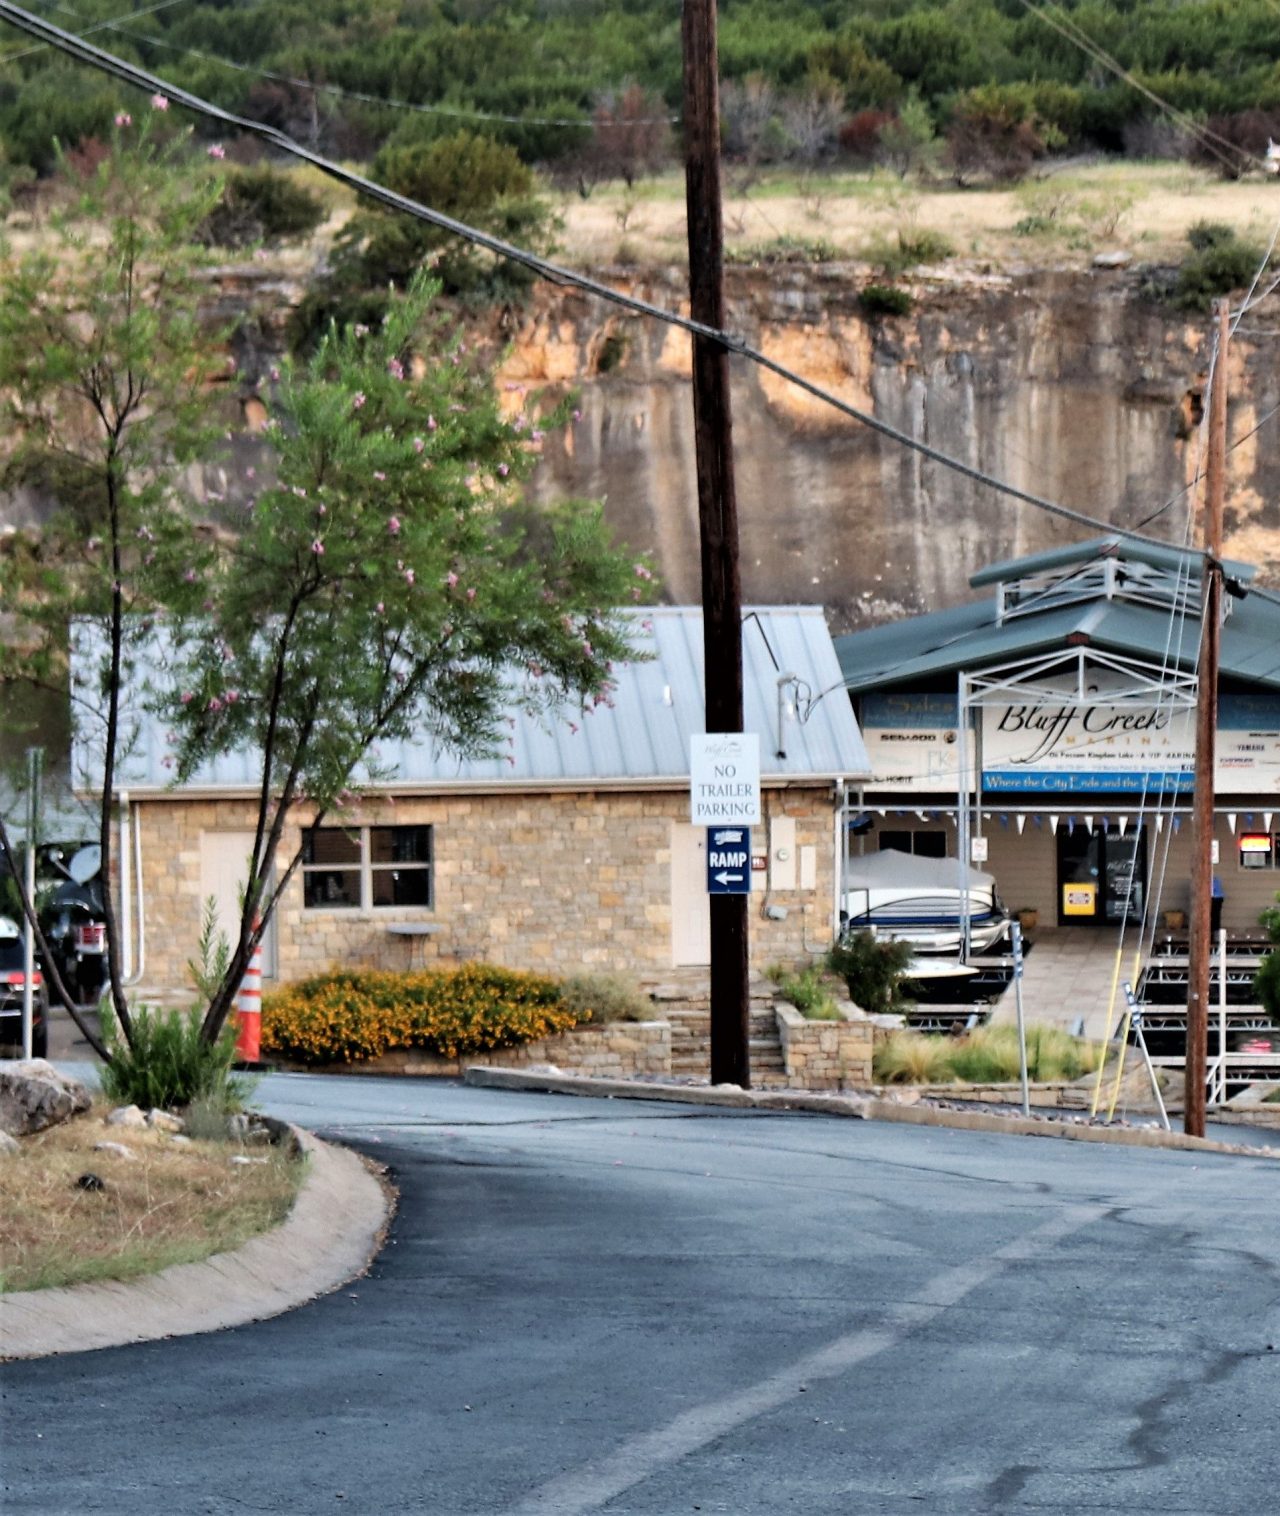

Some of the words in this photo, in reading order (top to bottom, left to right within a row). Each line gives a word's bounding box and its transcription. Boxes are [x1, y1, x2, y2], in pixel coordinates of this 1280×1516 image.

[997, 705, 1079, 765] Bluff
[1083, 705, 1168, 733] Creek
[1066, 735, 1170, 746] MARINA
[714, 764, 736, 778] NO
[984, 775, 1021, 788] Where
[1024, 775, 1040, 787] the
[1042, 775, 1068, 790] City
[1102, 776, 1121, 788] and
[1123, 776, 1138, 788] the
[699, 784, 753, 797] TRAILER
[697, 802, 755, 816] PARKING
[709, 852, 747, 868] RAMP
